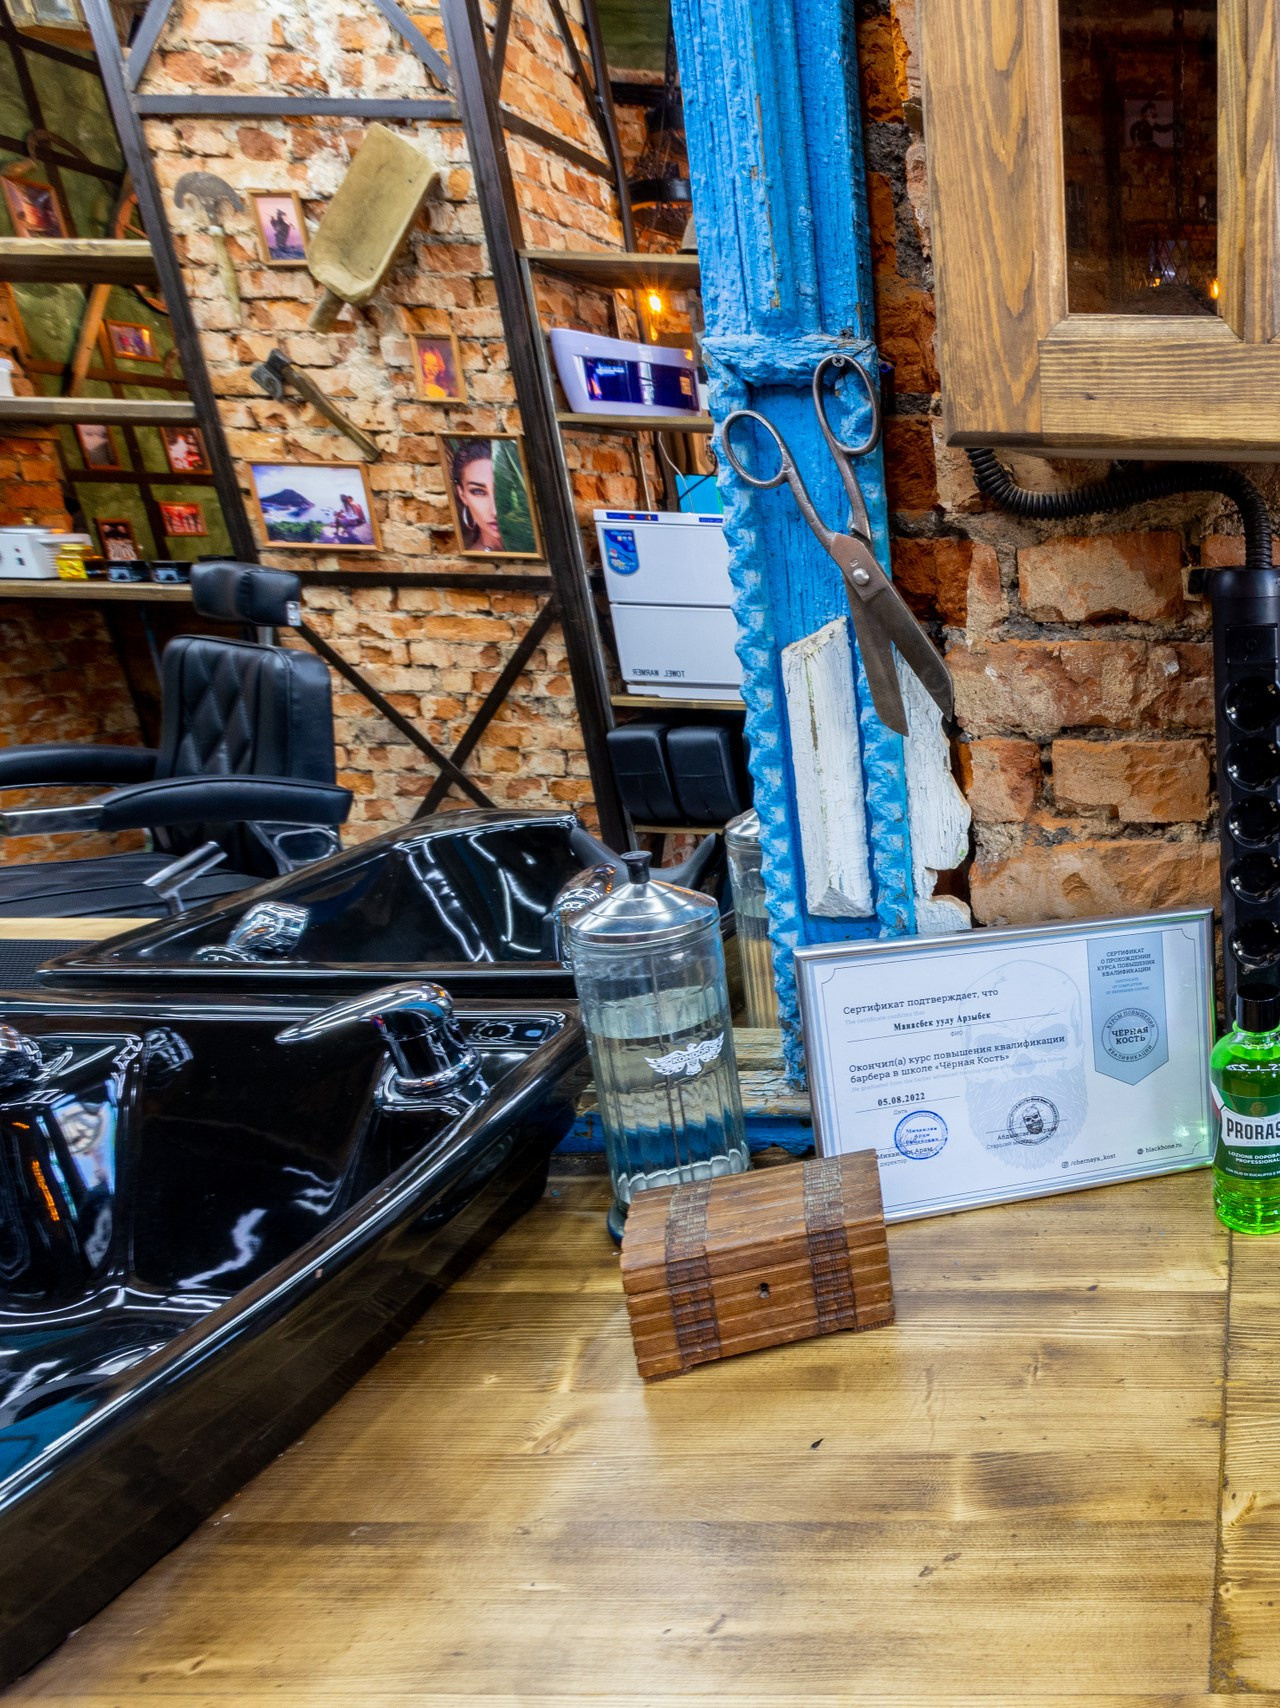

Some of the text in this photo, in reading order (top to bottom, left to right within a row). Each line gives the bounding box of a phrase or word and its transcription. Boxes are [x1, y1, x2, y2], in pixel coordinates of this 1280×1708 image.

[1106, 947, 1144, 957] СЕРТИФИКАТ
[1105, 953, 1151, 964] ПРОХОЖДЕНИИ
[1117, 959, 1155, 969] ПОВЫШЕНИЯ
[1101, 966, 1151, 977] КВАЛИФИКАЦИИ
[843, 989, 999, 1015] Сертификат подтверждает, что
[893, 1019, 934, 1032] Манасбек
[957, 1011, 991, 1024] Арзыбек
[1115, 1036, 1146, 1045] КОСТЬ
[848, 1036, 1065, 1073] Окончил(а) курс повышения квалификации
[850, 1071, 891, 1084] барбера
[901, 1065, 933, 1076] школе
[977, 1054, 1010, 1064] Кость»
[877, 1092, 926, 1106] 05.08.2022
[1228, 1150, 1253, 1160] LOZIONE
